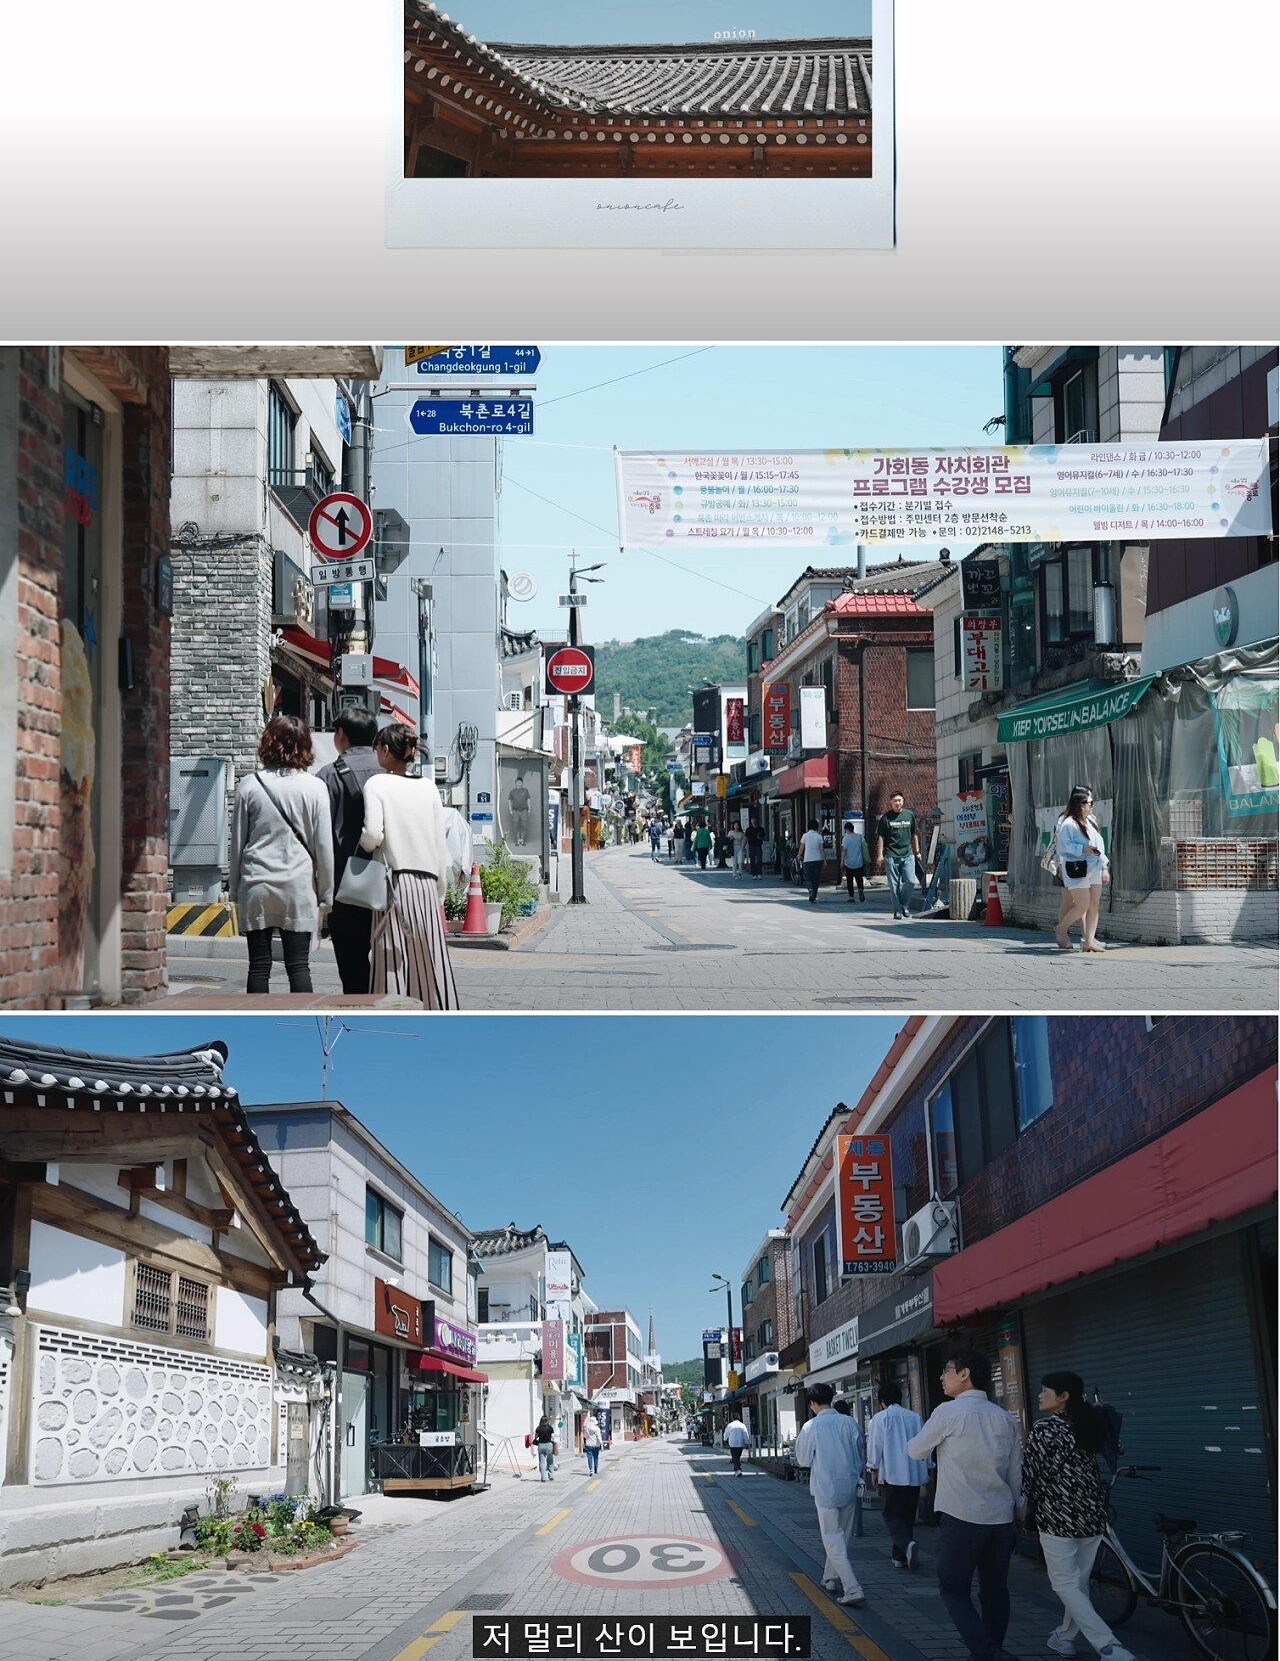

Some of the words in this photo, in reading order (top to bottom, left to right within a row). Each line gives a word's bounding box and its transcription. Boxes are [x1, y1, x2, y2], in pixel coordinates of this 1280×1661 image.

[713, 27, 756, 40] onion
[420, 361, 501, 374] Changdeokgung
[504, 362, 526, 374] 1-gil
[460, 403, 531, 420] 북촌로4길
[439, 422, 503, 432] Bukchon-ro
[505, 422, 530, 434] 4-gil
[746, 456, 793, 466] 13:30~15:00
[1091, 452, 1121, 462] 라인댄스
[1128, 451, 1137, 461] 화
[1139, 450, 1147, 461] 금
[1154, 450, 1202, 460] 10:30~12:00
[873, 456, 929, 476] 가회동
[935, 455, 1010, 475] 자치회관
[756, 471, 799, 480] 15:15~17:45
[1056, 469, 1124, 481] 영어뮤지컬(6~7세)
[1131, 469, 1139, 478] 수
[1147, 468, 1194, 477] 16:30~17:30
[753, 485, 799, 494] 16:00~17:30
[853, 478, 927, 497] 프로그램
[933, 477, 989, 496] 수강생
[994, 475, 1031, 494] 모집
[859, 501, 895, 512] 접수기간
[935, 500, 953, 510] 접수
[1069, 504, 1092, 514] 어린이
[1094, 504, 1124, 513] 바이올린
[1147, 502, 1195, 511] 16:30~18:00
[860, 515, 896, 526] 접수방법
[905, 514, 941, 525] 주민센터
[944, 513, 959, 523] 2층
[962, 512, 1008, 523] 방문선착순
[1111, 520, 1133, 530] 디저트
[1156, 518, 1204, 528] 14:00~16:00
[720, 527, 734, 537] 요가
[767, 526, 814, 535] 10:30~12:00
[860, 528, 905, 539] 카드결제만
[908, 527, 927, 538] 가능
[938, 527, 956, 537] 문의
[965, 525, 1032, 536] 02)2148-5213
[318, 564, 367, 580] 일방통행
[967, 631, 990, 691] 부대고기
[1081, 692, 1130, 724] BALANCE
[768, 697, 785, 746] 부동산
[844, 1140, 884, 1156] 계동
[849, 1162, 886, 1255] 부동산
[846, 1260, 895, 1273] T.763-3940
